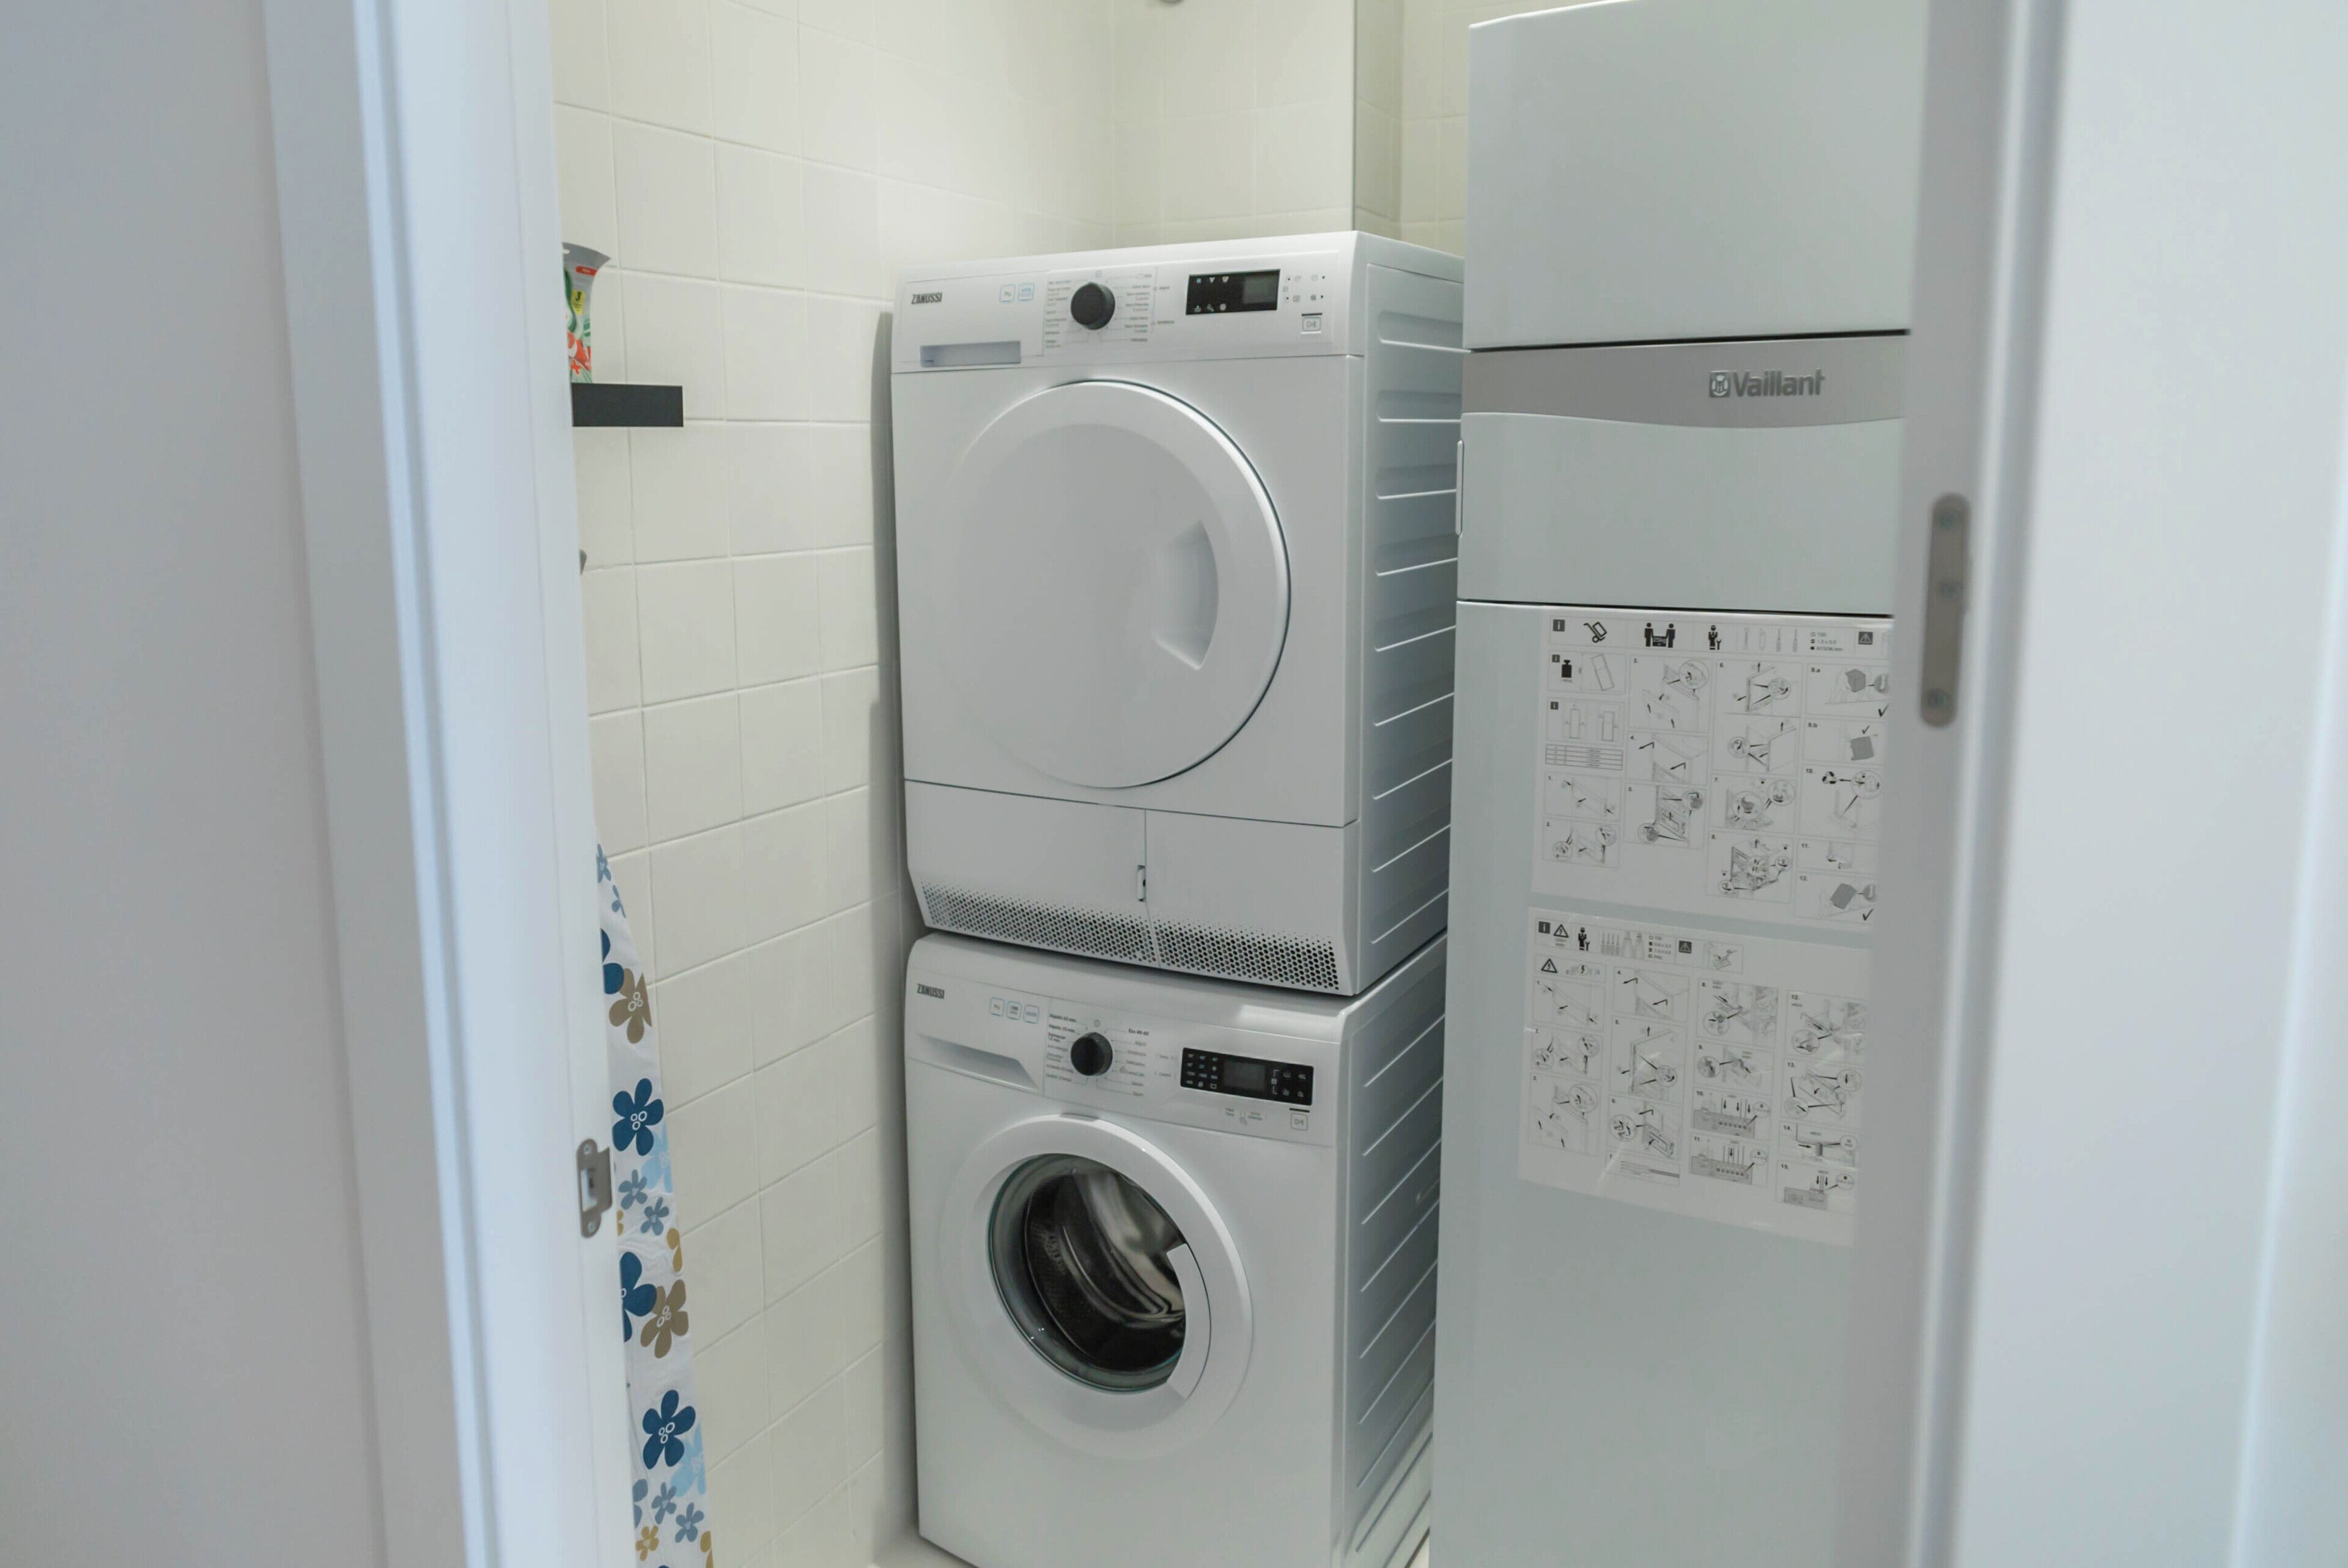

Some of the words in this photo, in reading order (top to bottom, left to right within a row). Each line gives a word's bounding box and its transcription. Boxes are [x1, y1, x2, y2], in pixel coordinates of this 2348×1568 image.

[911, 292, 943, 304] ZANUSSI
[1733, 368, 1825, 397] Vaillant
[917, 983, 945, 999] ZANUSSI
